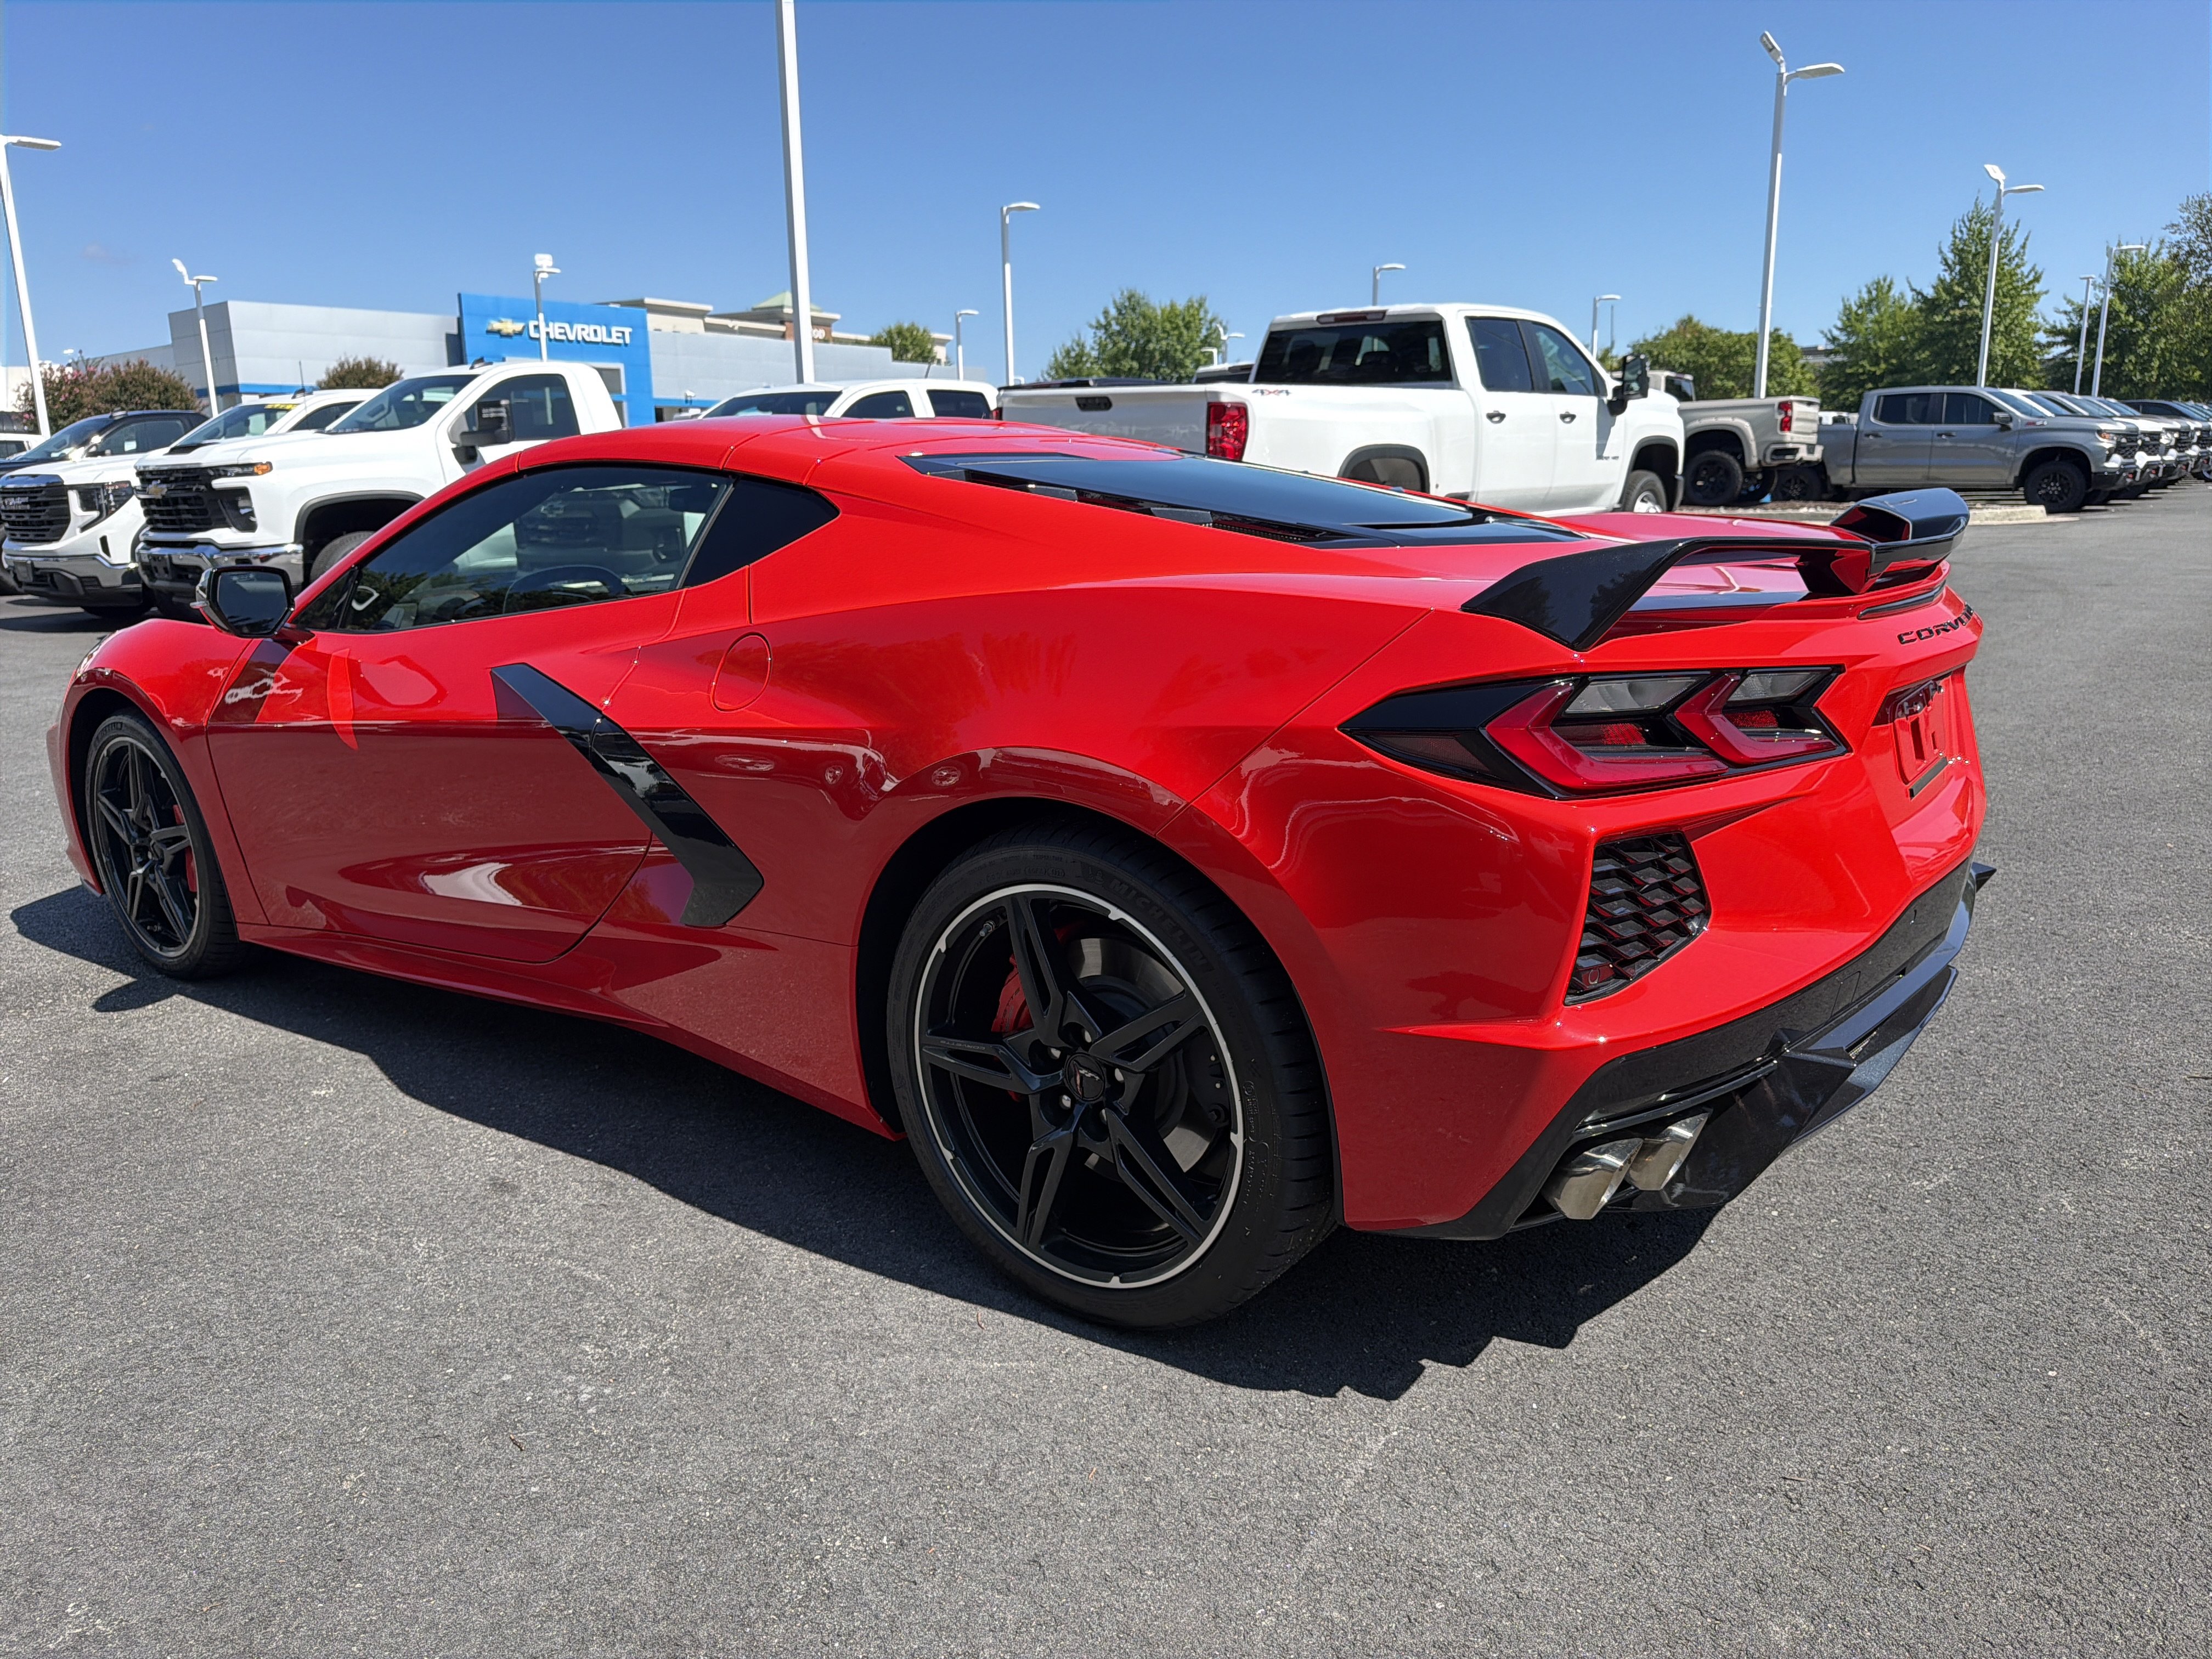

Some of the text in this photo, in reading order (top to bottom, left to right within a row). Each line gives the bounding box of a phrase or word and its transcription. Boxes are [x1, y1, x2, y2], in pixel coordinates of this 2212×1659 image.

[528, 320, 633, 345] CHEVROLET
[1109, 878, 1206, 966] MICHELIN
[940, 1040, 985, 1050] CORVETTE
